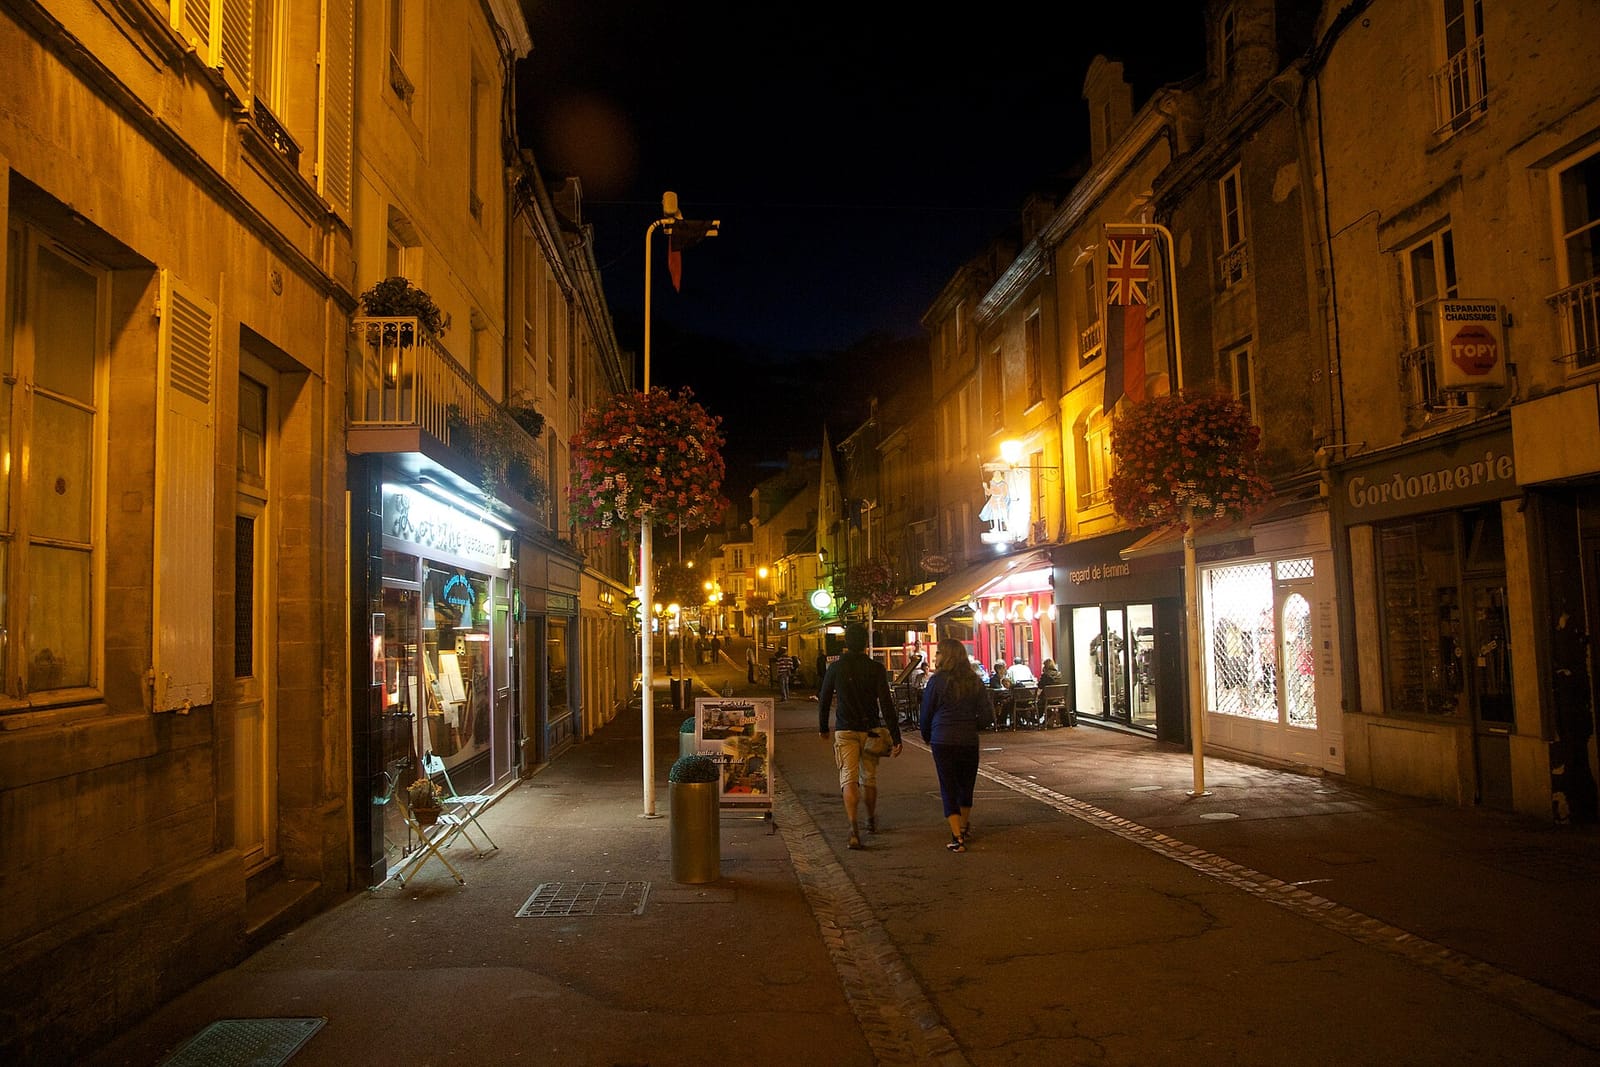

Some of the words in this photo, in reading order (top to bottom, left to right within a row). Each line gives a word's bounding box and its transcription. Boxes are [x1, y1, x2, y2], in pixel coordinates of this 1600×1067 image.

[1445, 313, 1497, 322] CHAUSSURES
[1451, 343, 1496, 358] TOPY
[1349, 452, 1513, 507] Cordonnerie
[1070, 566, 1090, 584] regard
[1092, 565, 1101, 580] de
